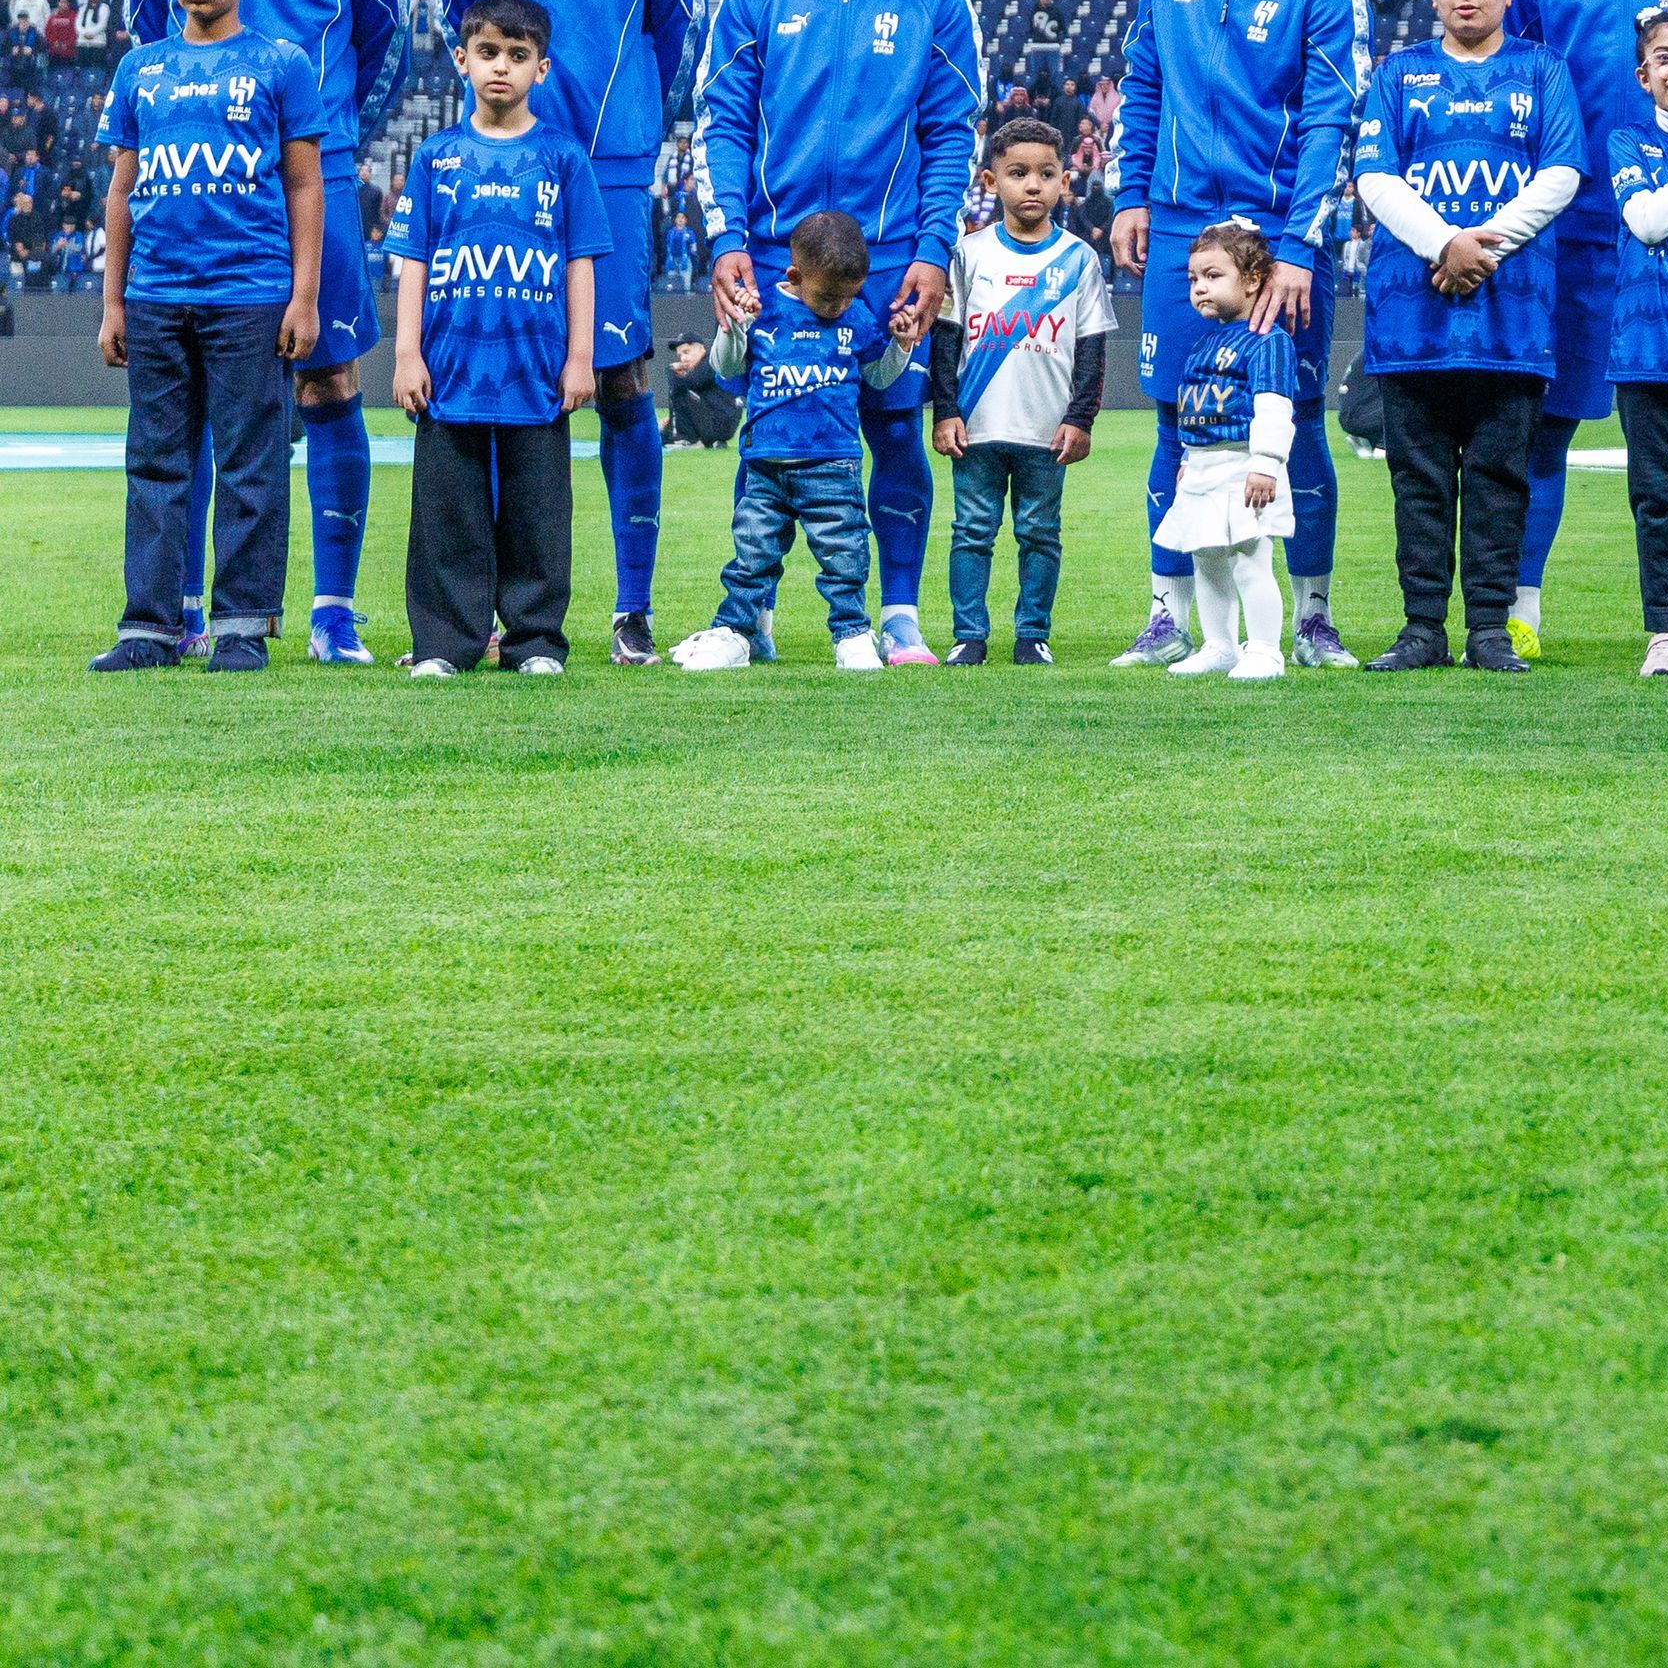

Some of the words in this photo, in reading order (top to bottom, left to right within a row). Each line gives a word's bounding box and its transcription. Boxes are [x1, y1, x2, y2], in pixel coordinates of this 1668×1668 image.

[137, 142, 263, 182] SAVVY
[134, 183, 182, 198] GAMES
[191, 182, 258, 195] GROUP
[1405, 159, 1532, 197] SAVVY
[1470, 201, 1505, 212] GRO
[428, 243, 559, 287] SAVVY
[430, 285, 486, 303] GAMES
[494, 285, 554, 304] GROUP
[968, 309, 1066, 343] SAVVY
[760, 364, 849, 388] SAVVY
[762, 387, 802, 398] GAMES
